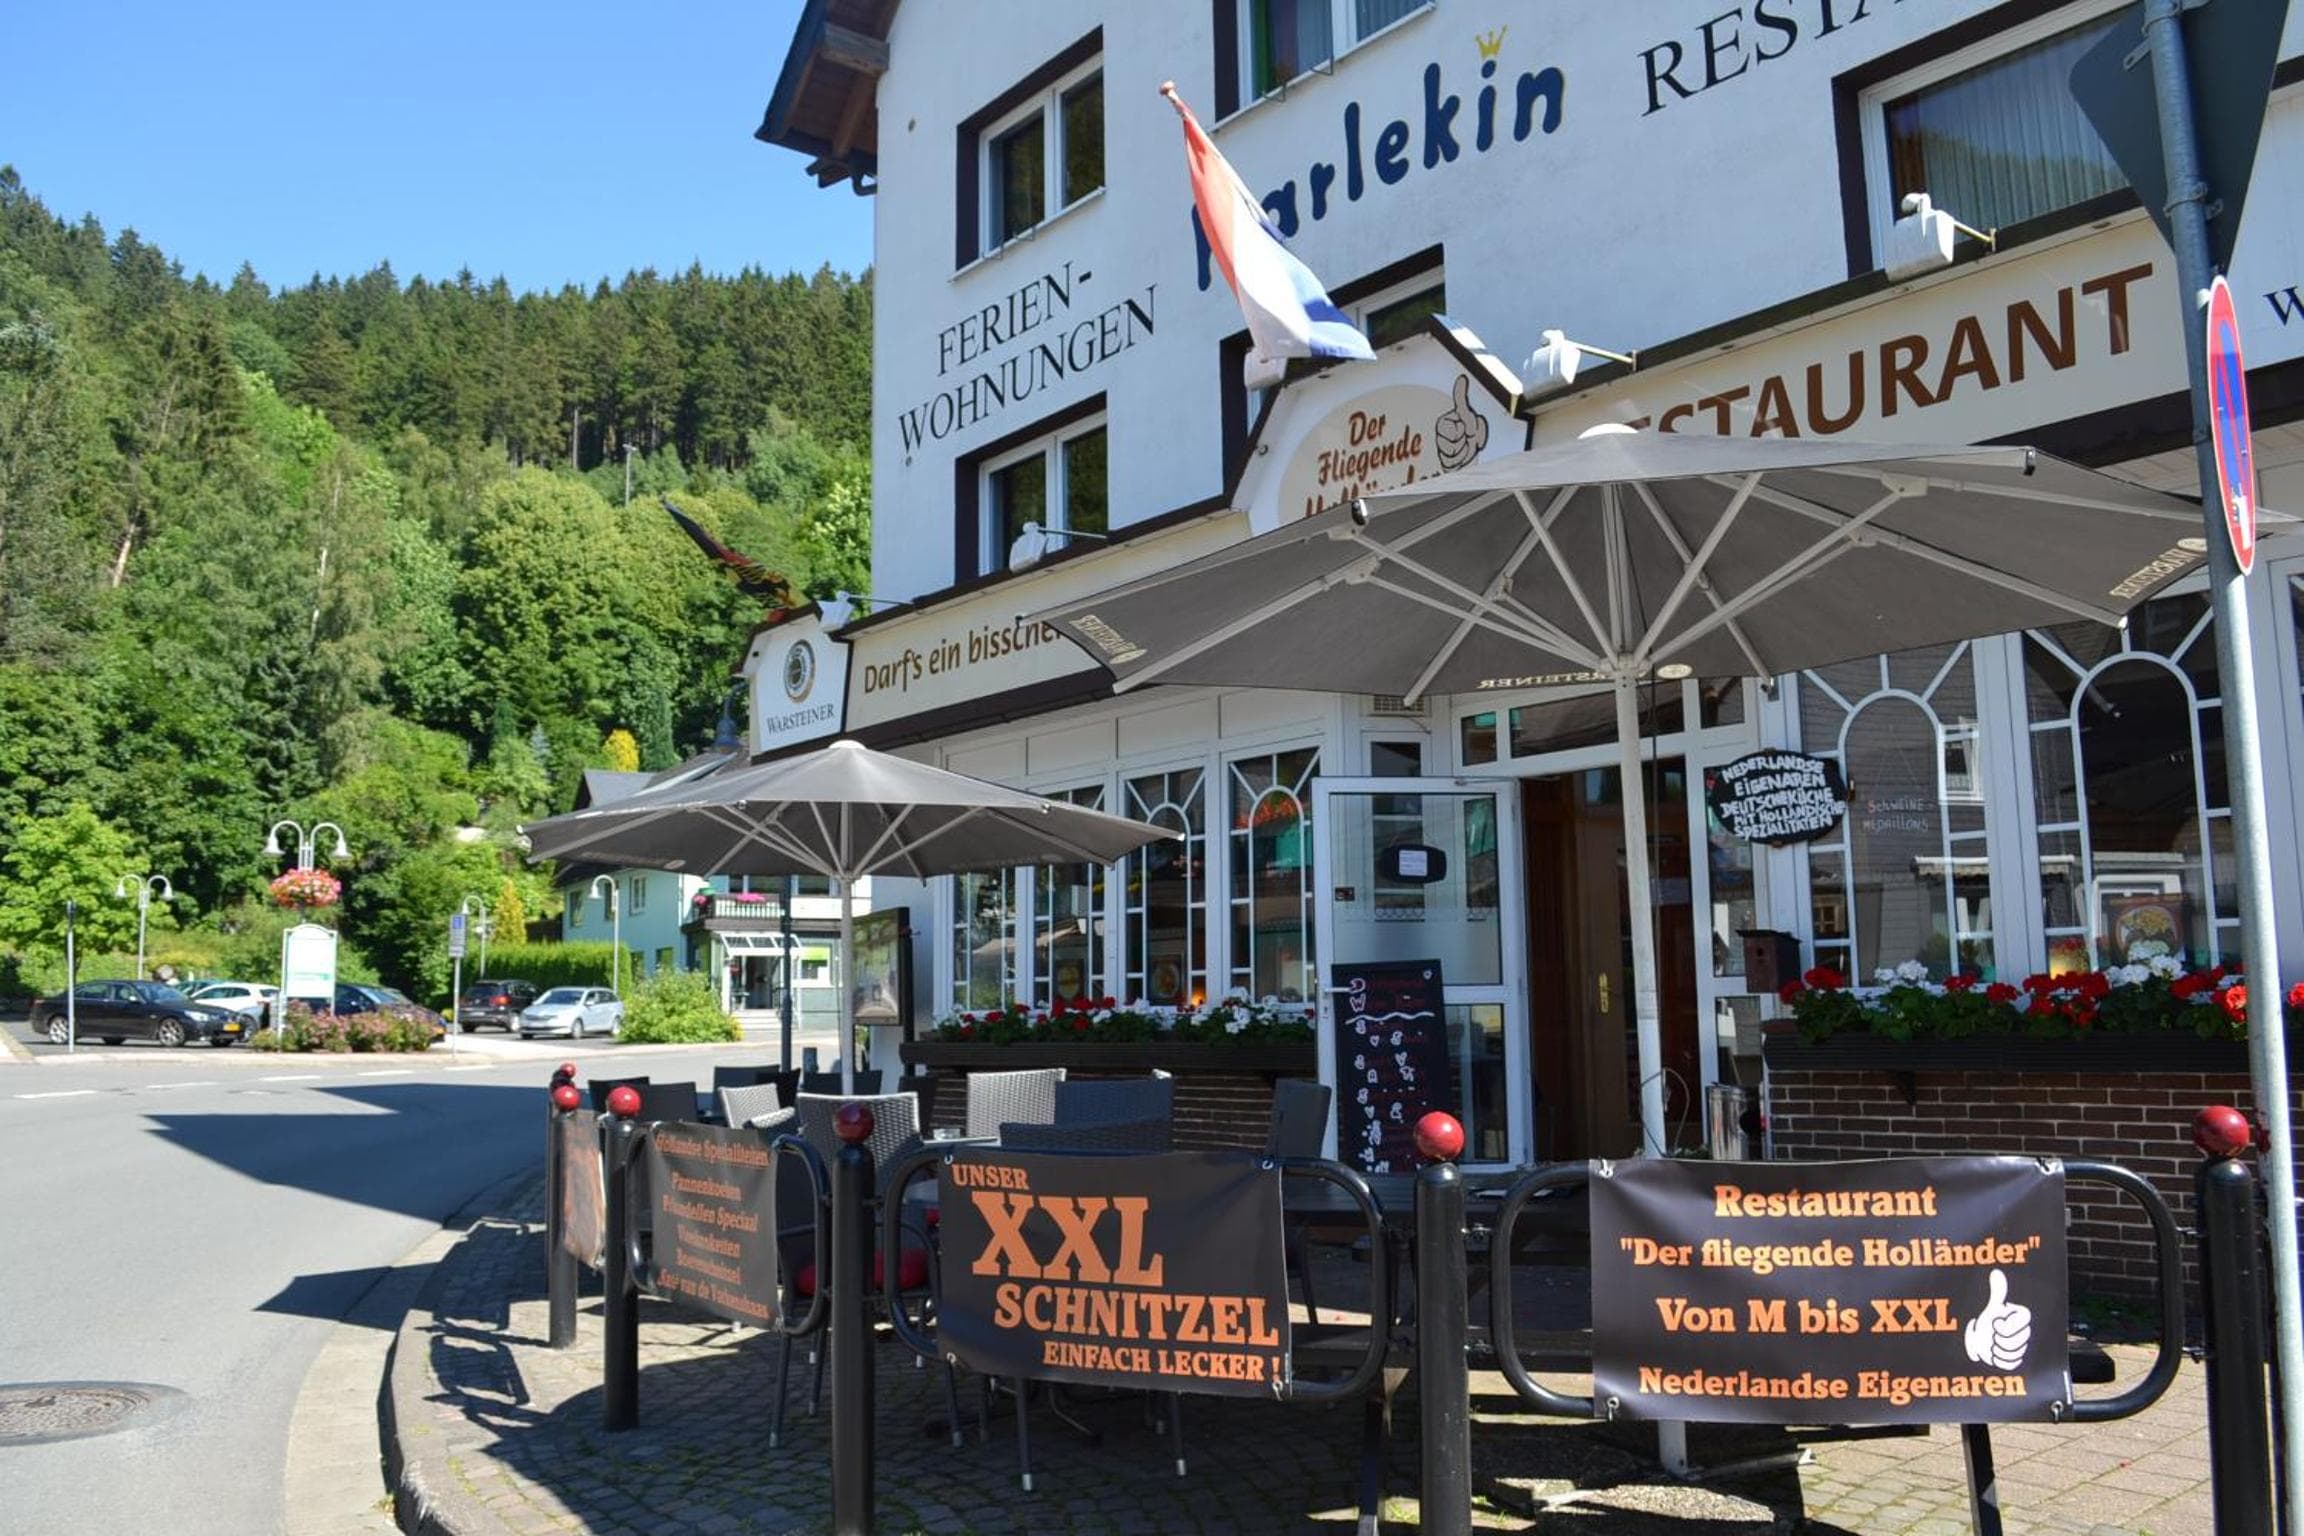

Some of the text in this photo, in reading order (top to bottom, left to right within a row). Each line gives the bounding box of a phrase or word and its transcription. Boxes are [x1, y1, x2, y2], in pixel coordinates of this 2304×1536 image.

[938, 261, 1092, 377] FERIEN-
[898, 284, 1158, 454] WOHNUNGEN
[1349, 411, 1386, 446] Der
[1318, 424, 1423, 486] Fliegende
[864, 649, 922, 694] Darf's
[929, 639, 960, 675] ein
[767, 704, 834, 735] WARSTEINER
[1722, 755, 1824, 784] NEDERLANDSE
[951, 1163, 1029, 1190] UNSER
[1714, 1185, 1937, 1218] Restaurant
[971, 1191, 1163, 1287] XXL
[1620, 1236, 2041, 1275] "Der fliegende Holländer"
[994, 1283, 1279, 1346] SCHNITZEL
[1656, 1298, 1958, 1334] Von M bis XXL
[1043, 1340, 1151, 1374] EINFACH
[1638, 1366, 2027, 1405] Nederlandse Eigenaren
